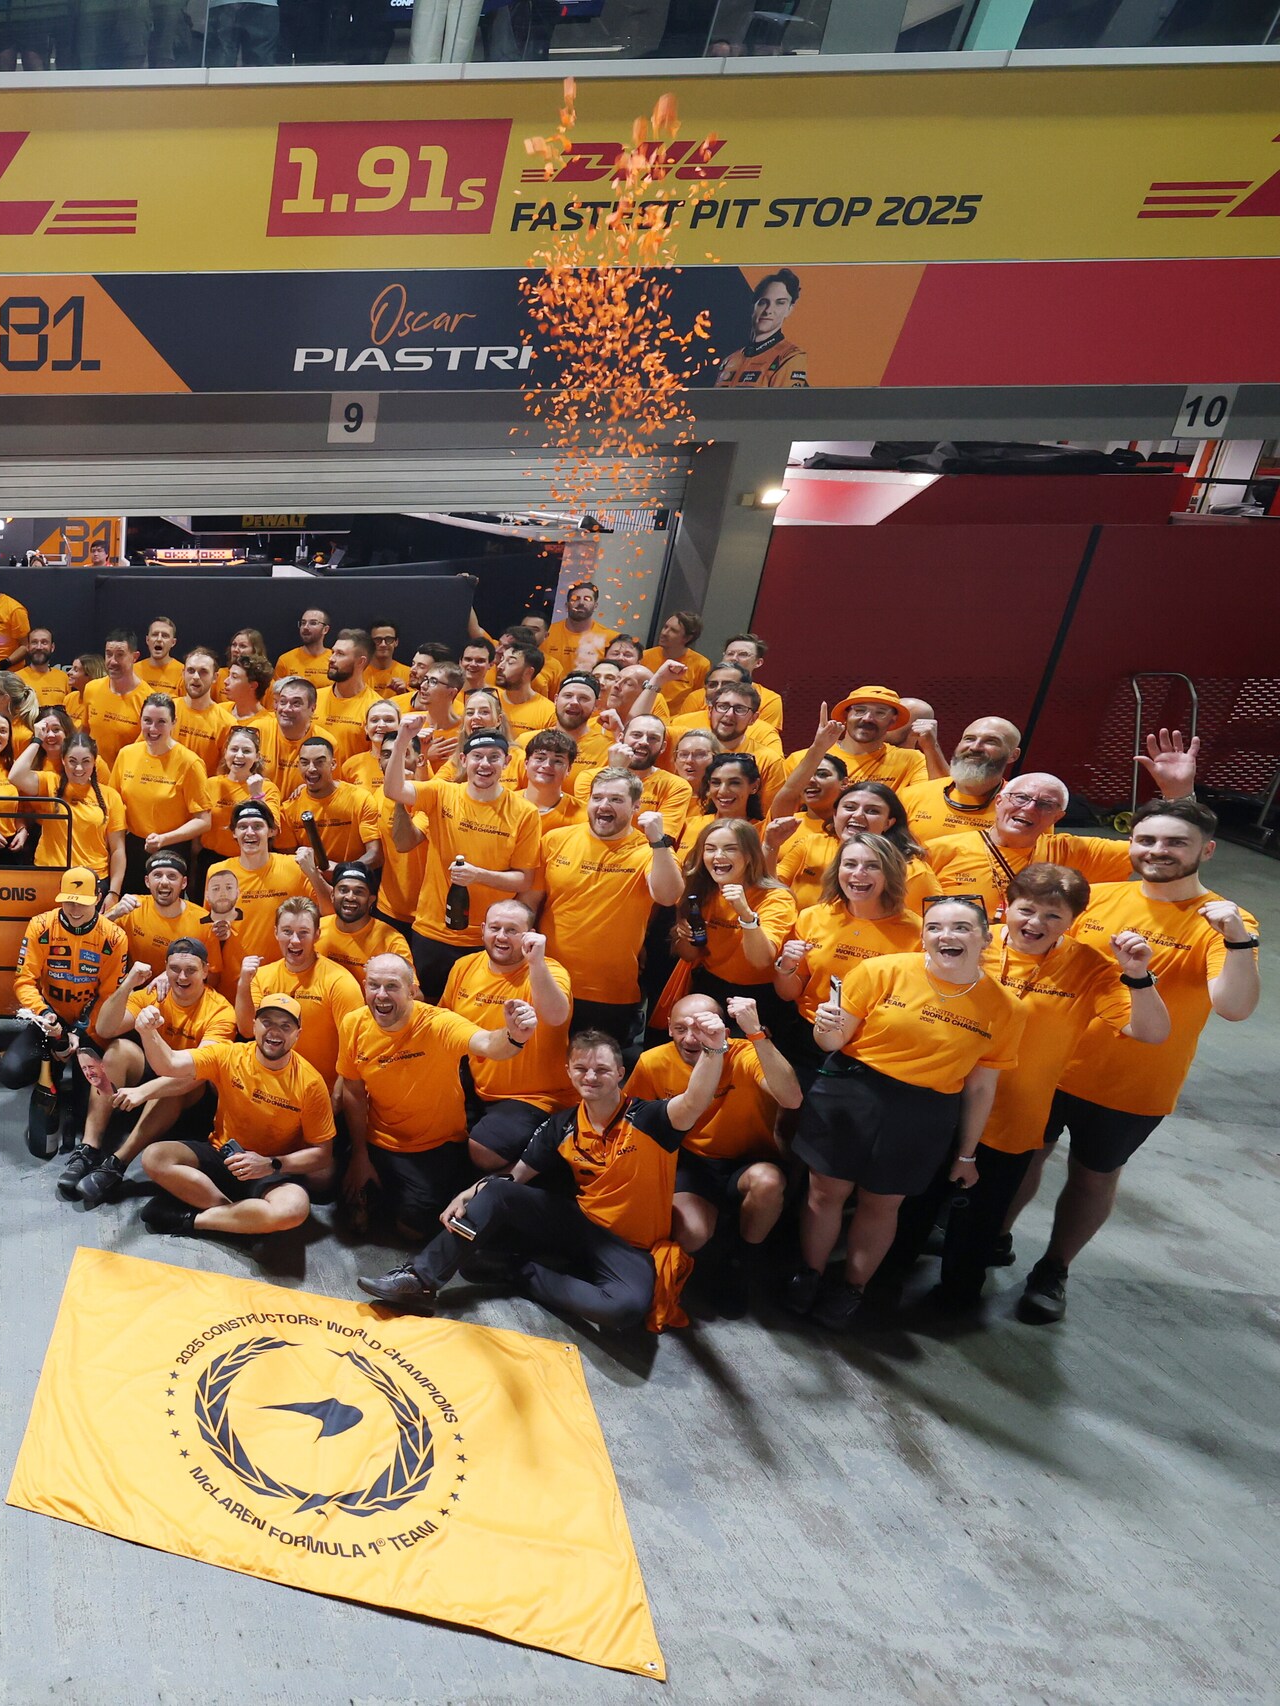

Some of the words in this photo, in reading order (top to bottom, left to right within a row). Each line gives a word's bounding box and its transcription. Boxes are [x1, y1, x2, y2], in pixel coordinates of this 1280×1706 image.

[553, 140, 728, 182] DHL
[282, 145, 487, 213] 1.91s
[510, 200, 686, 232] FASTEST
[690, 198, 761, 229] PIT
[764, 197, 873, 228] STOP
[876, 194, 984, 226] 2025
[371, 283, 477, 346] Oscar
[293, 345, 533, 372] PIASTRI
[342, 402, 364, 434] 9
[1185, 395, 1228, 428] 10
[944, 817, 969, 826] WORLD
[1084, 923, 1105, 932] TEAM
[835, 948, 861, 958] WORLD
[883, 998, 907, 1009] TEAM
[1025, 985, 1076, 998] CHAMPIONS
[921, 1009, 950, 1023] WORLD
[951, 1018, 993, 1040] CHAMPIONS
[176, 1338, 205, 1365] 2025
[202, 1313, 323, 1341] CONSTRUCTORS'
[326, 1321, 382, 1350] WORLD
[382, 1347, 458, 1424] CHAMPIONS
[189, 1466, 267, 1531] McLAREN
[268, 1525, 367, 1558] FORMULA
[387, 1518, 439, 1552] TEAM
